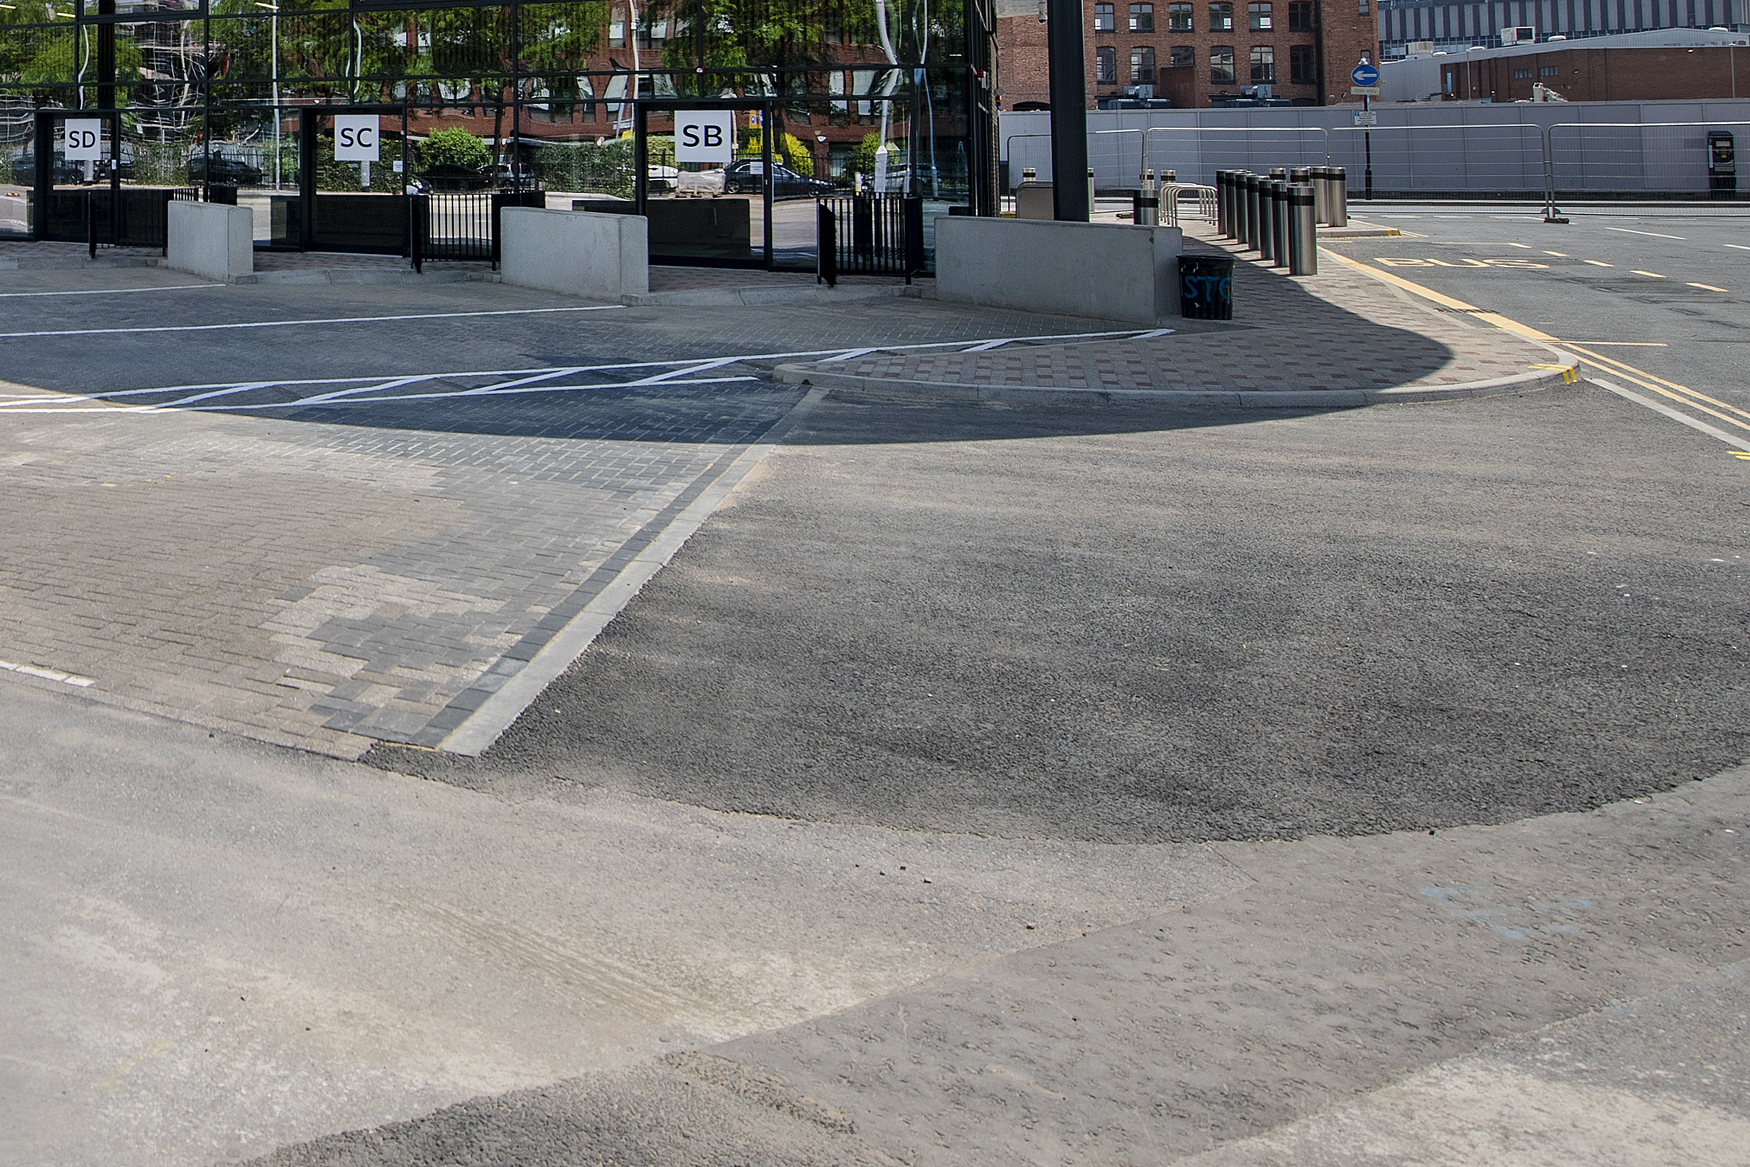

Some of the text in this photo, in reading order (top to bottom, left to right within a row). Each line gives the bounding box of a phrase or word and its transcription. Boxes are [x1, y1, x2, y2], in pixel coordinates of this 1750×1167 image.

[68, 130, 96, 149] SD
[340, 127, 373, 148] SC
[682, 124, 723, 148] SB
[1373, 257, 1550, 269] BUS
